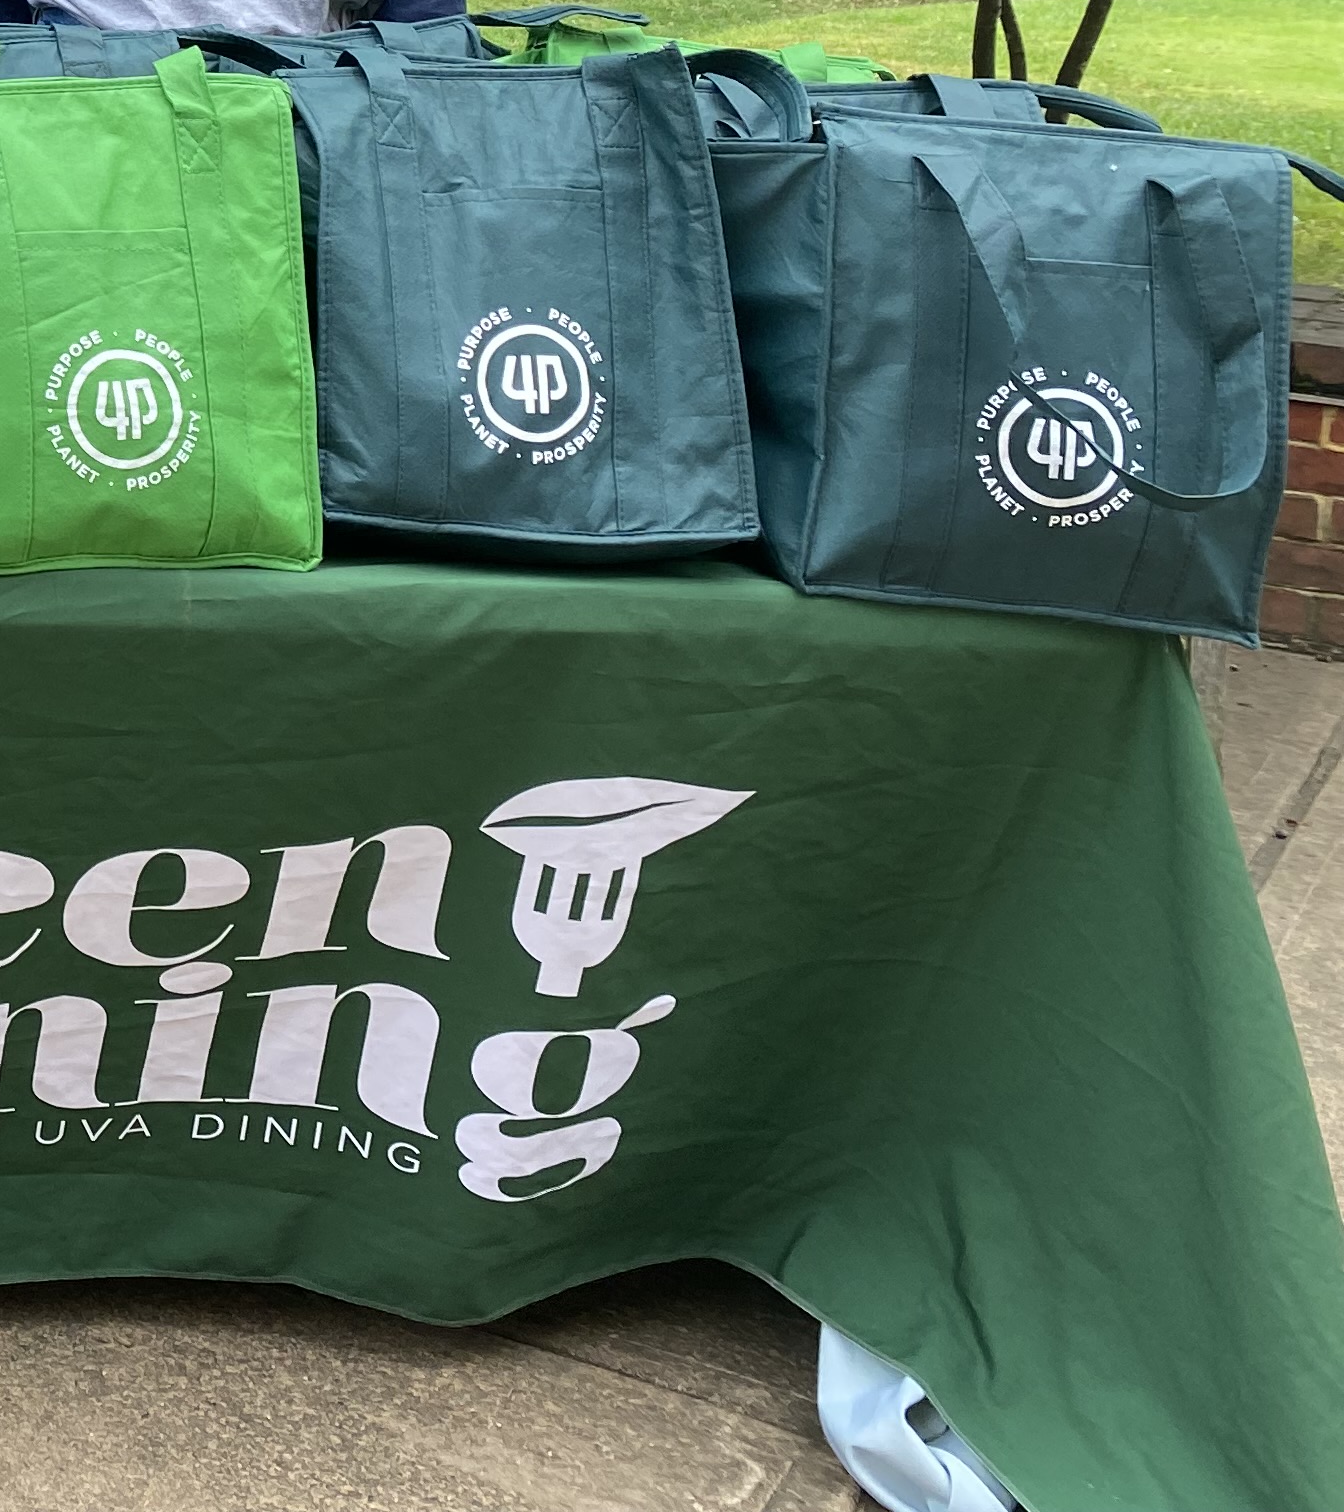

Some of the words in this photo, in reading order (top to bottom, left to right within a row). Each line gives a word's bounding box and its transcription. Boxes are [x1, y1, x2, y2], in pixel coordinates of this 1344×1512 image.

[45, 330, 103, 400] PURPOSE
[135, 329, 193, 382] PEOPLE
[457, 307, 512, 370] PURPOSE
[548, 308, 603, 364] PEOPLE
[96, 378, 158, 440] 4P
[502, 355, 567, 414] 4P
[1085, 372, 1141, 432] PEOPLE
[47, 425, 100, 483] PLANET
[127, 410, 201, 491] PROSPERITY
[460, 394, 510, 454] PLANET
[532, 392, 607, 464] PROSPERITY
[975, 454, 1025, 516] PLANET
[1049, 460, 1144, 527] PROSPERY
[35, 1114, 151, 1145] UVA
[191, 1114, 421, 1173] DINING
